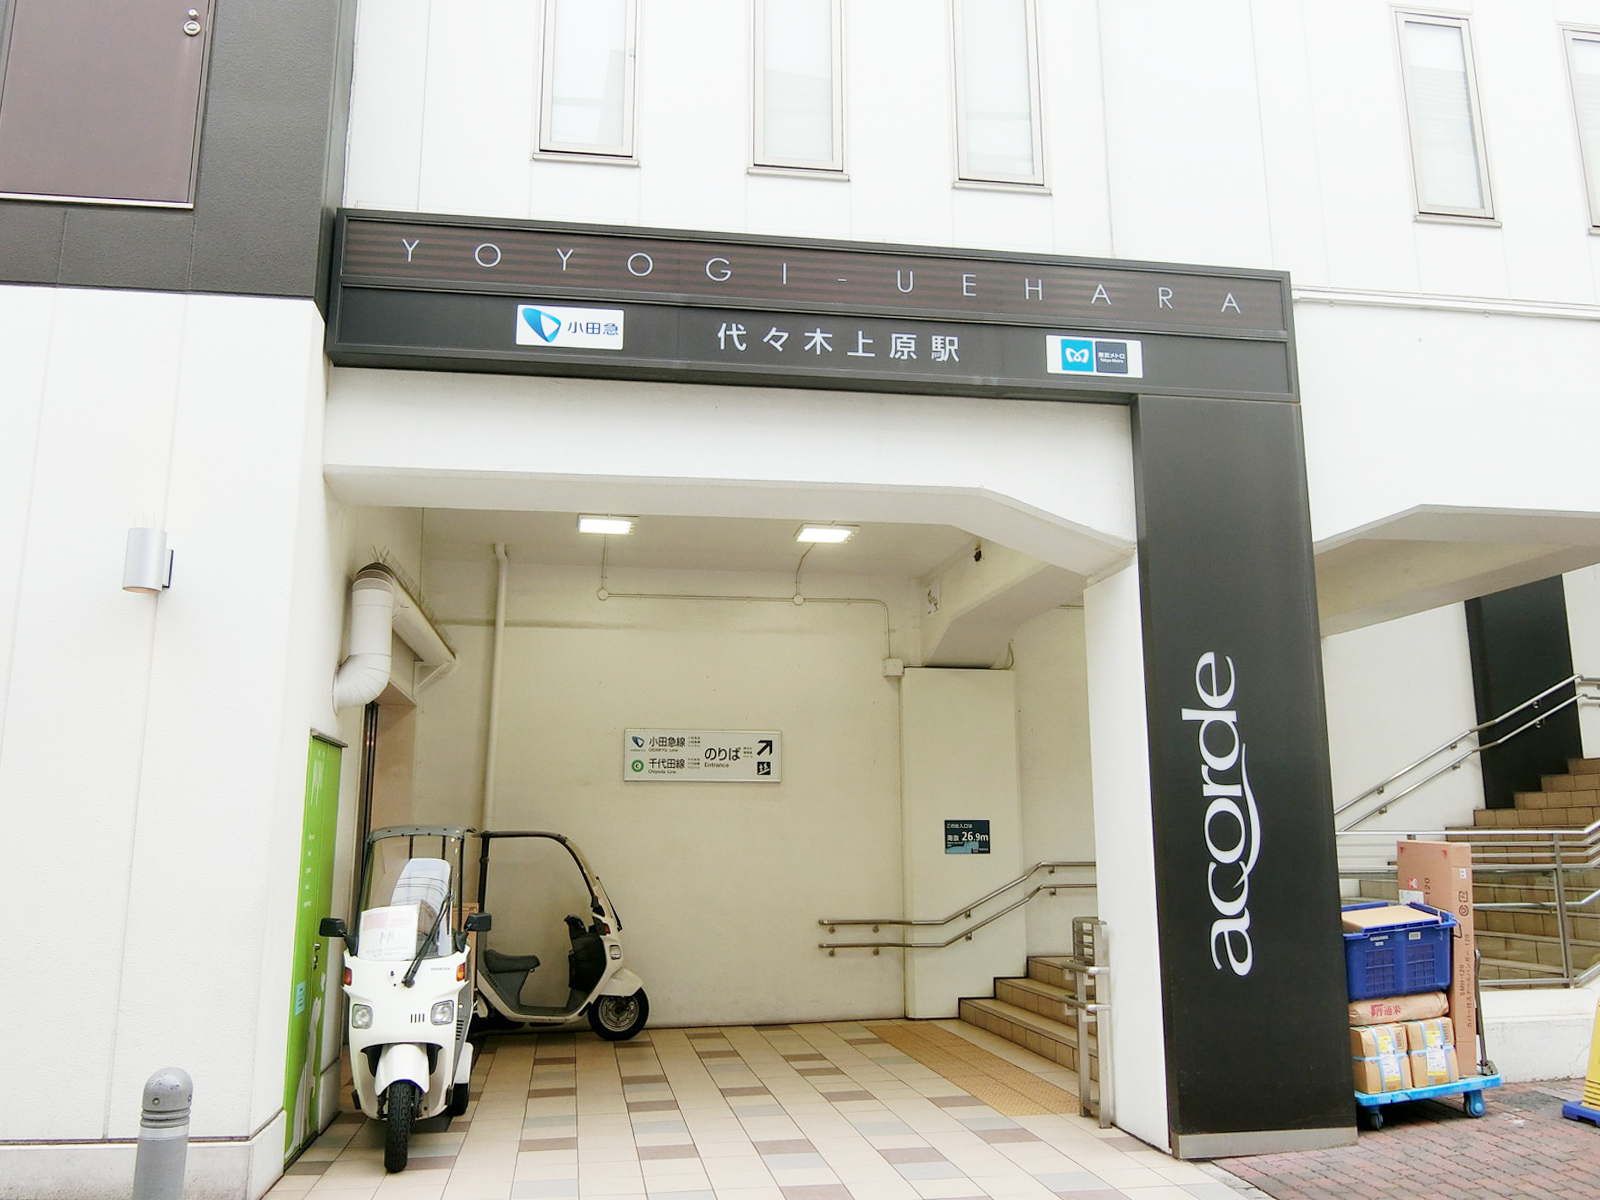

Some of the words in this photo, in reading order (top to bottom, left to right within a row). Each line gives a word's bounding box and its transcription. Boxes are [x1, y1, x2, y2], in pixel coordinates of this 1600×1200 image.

[567, 321, 619, 336] 小田急
[717, 322, 960, 362] 代々木上原駅
[649, 736, 686, 748] 小田急線
[704, 747, 741, 761] のりば
[648, 758, 686, 769] 千代田線
[961, 831, 989, 841] 26.9m
